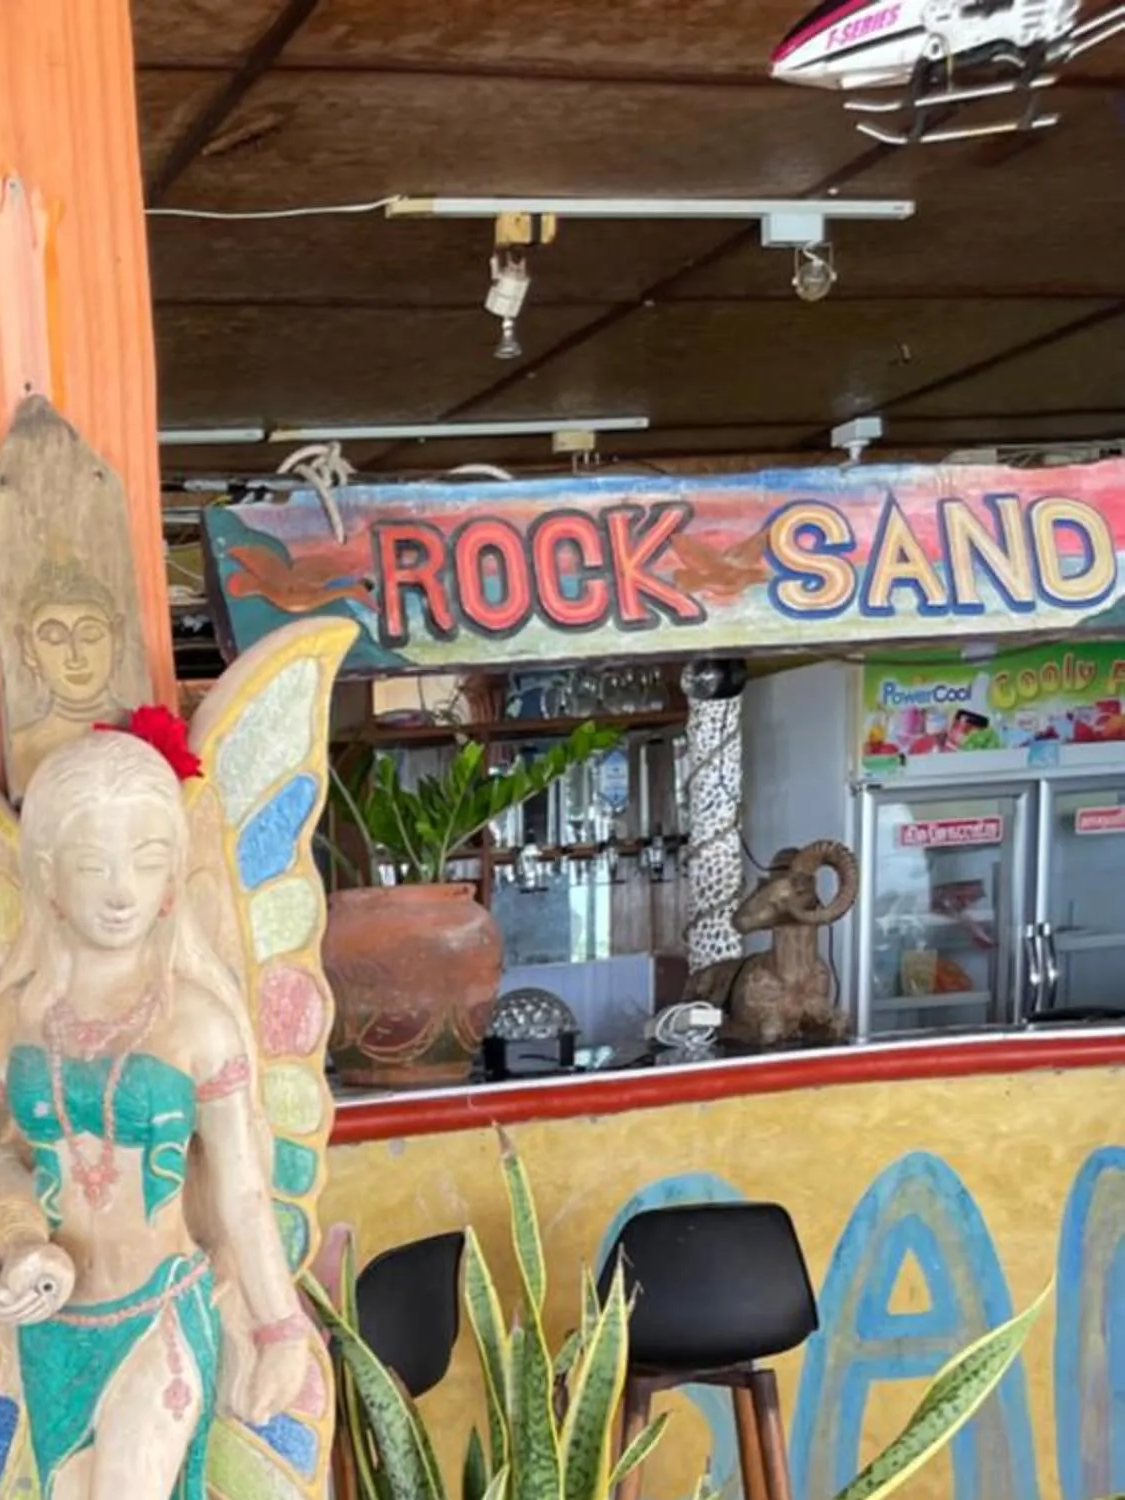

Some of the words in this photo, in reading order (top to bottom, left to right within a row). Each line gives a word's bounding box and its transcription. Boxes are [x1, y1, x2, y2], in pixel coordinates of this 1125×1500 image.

[370, 499, 707, 648] ROCK
[765, 490, 1118, 621] SAND
[882, 681, 973, 706] PowerCool
